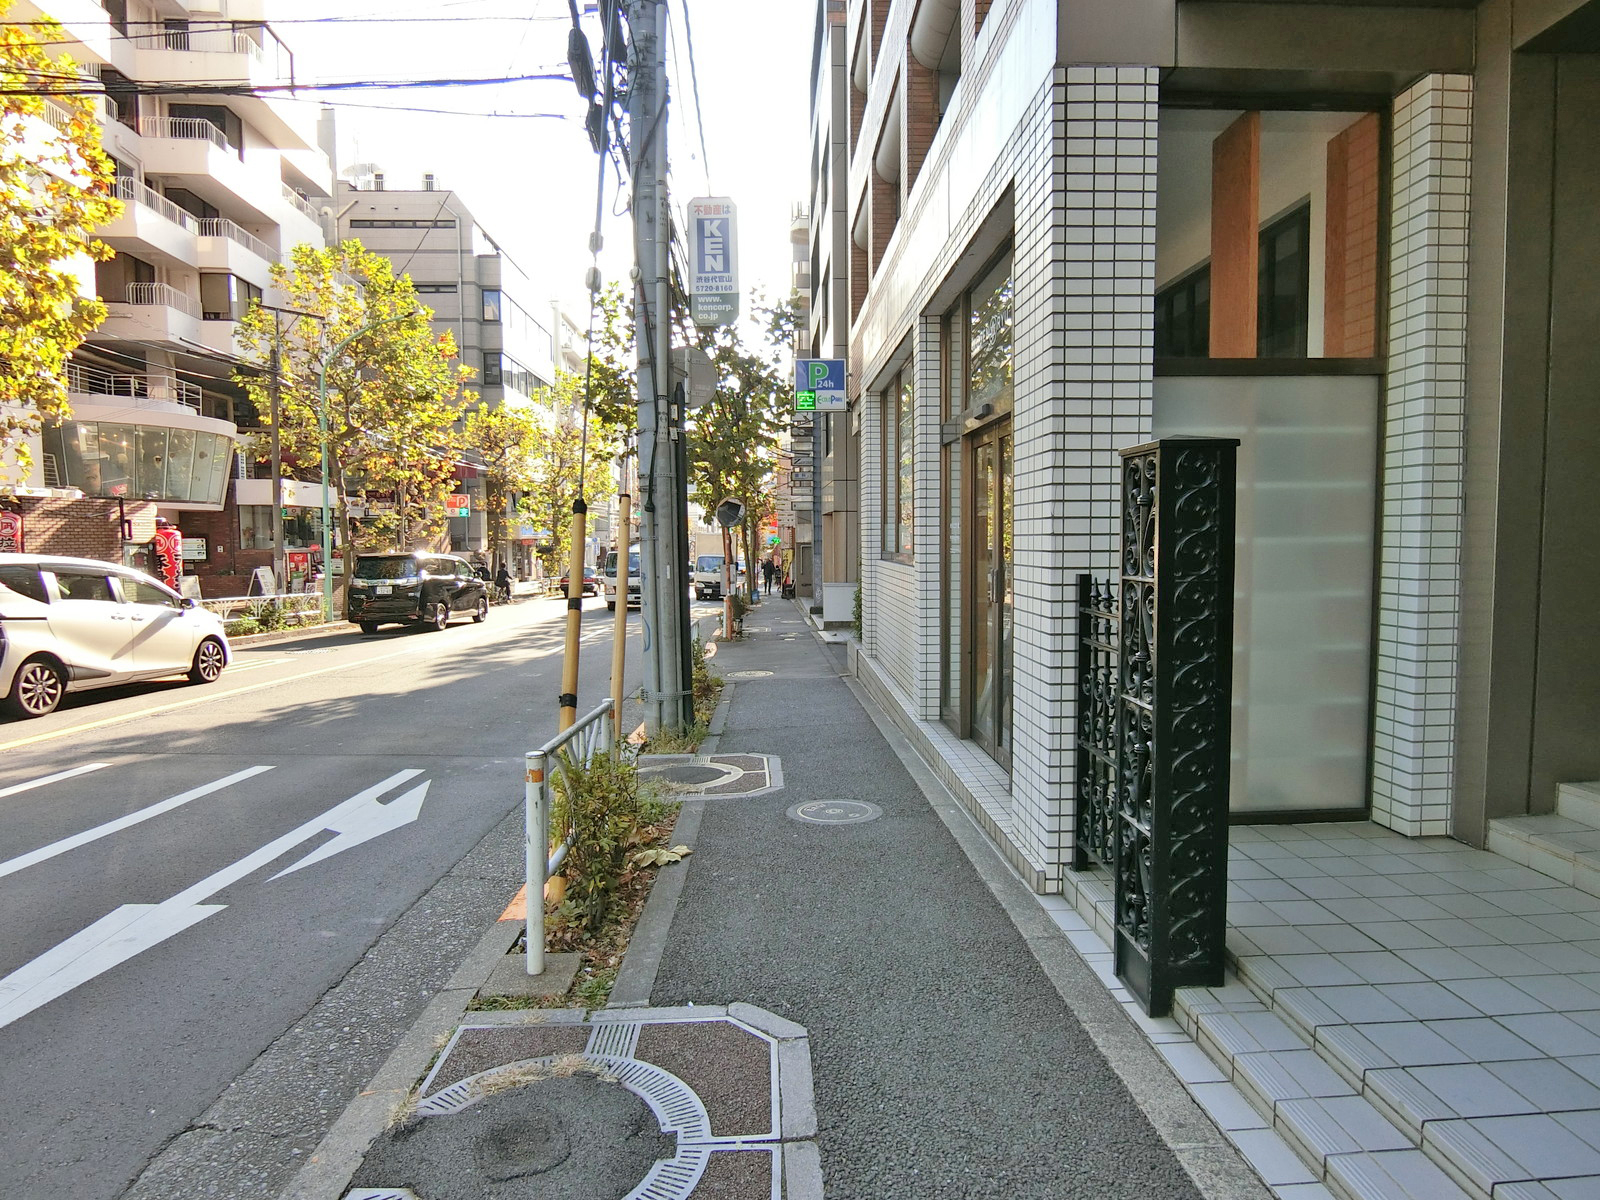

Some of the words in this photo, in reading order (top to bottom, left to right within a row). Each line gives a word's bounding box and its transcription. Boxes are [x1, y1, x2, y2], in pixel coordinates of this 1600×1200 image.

[694, 204, 731, 215] 不動産は
[704, 220, 723, 272] KEN
[696, 275, 732, 283] 渋谷代官山
[698, 303, 734, 312] kencorp.
[698, 312, 718, 320] co.jp
[809, 362, 829, 388] P
[817, 380, 834, 388] 24h
[797, 391, 815, 409] 空
